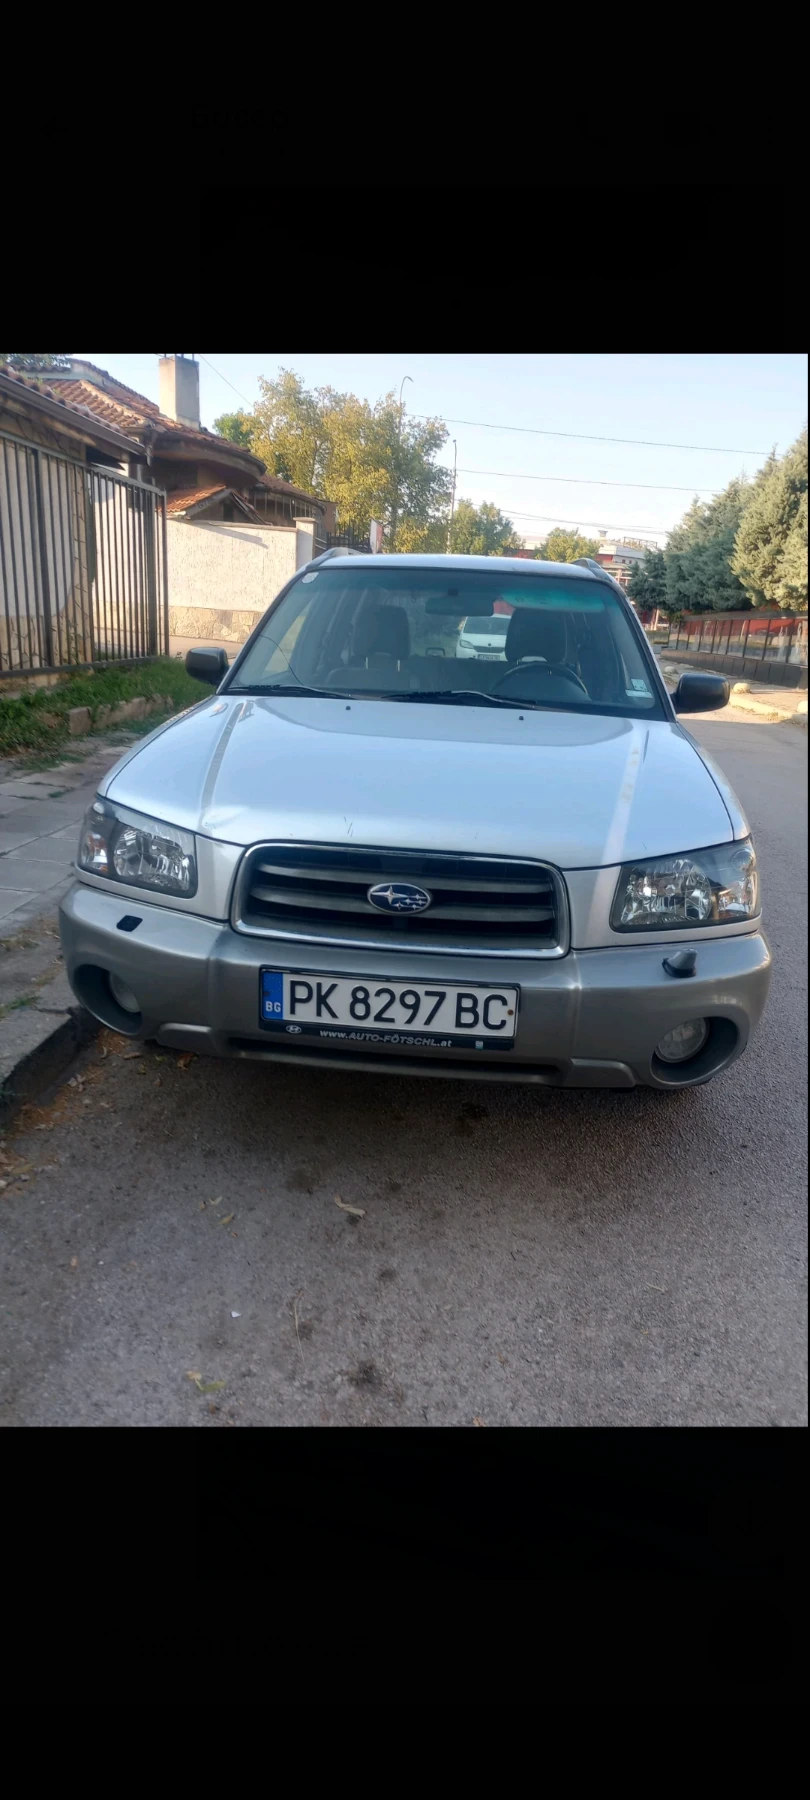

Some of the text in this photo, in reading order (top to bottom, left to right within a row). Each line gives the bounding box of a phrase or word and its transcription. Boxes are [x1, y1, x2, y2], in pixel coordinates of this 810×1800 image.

[265, 1000, 282, 1014] BG
[289, 980, 508, 1031] PK 8297 BC
